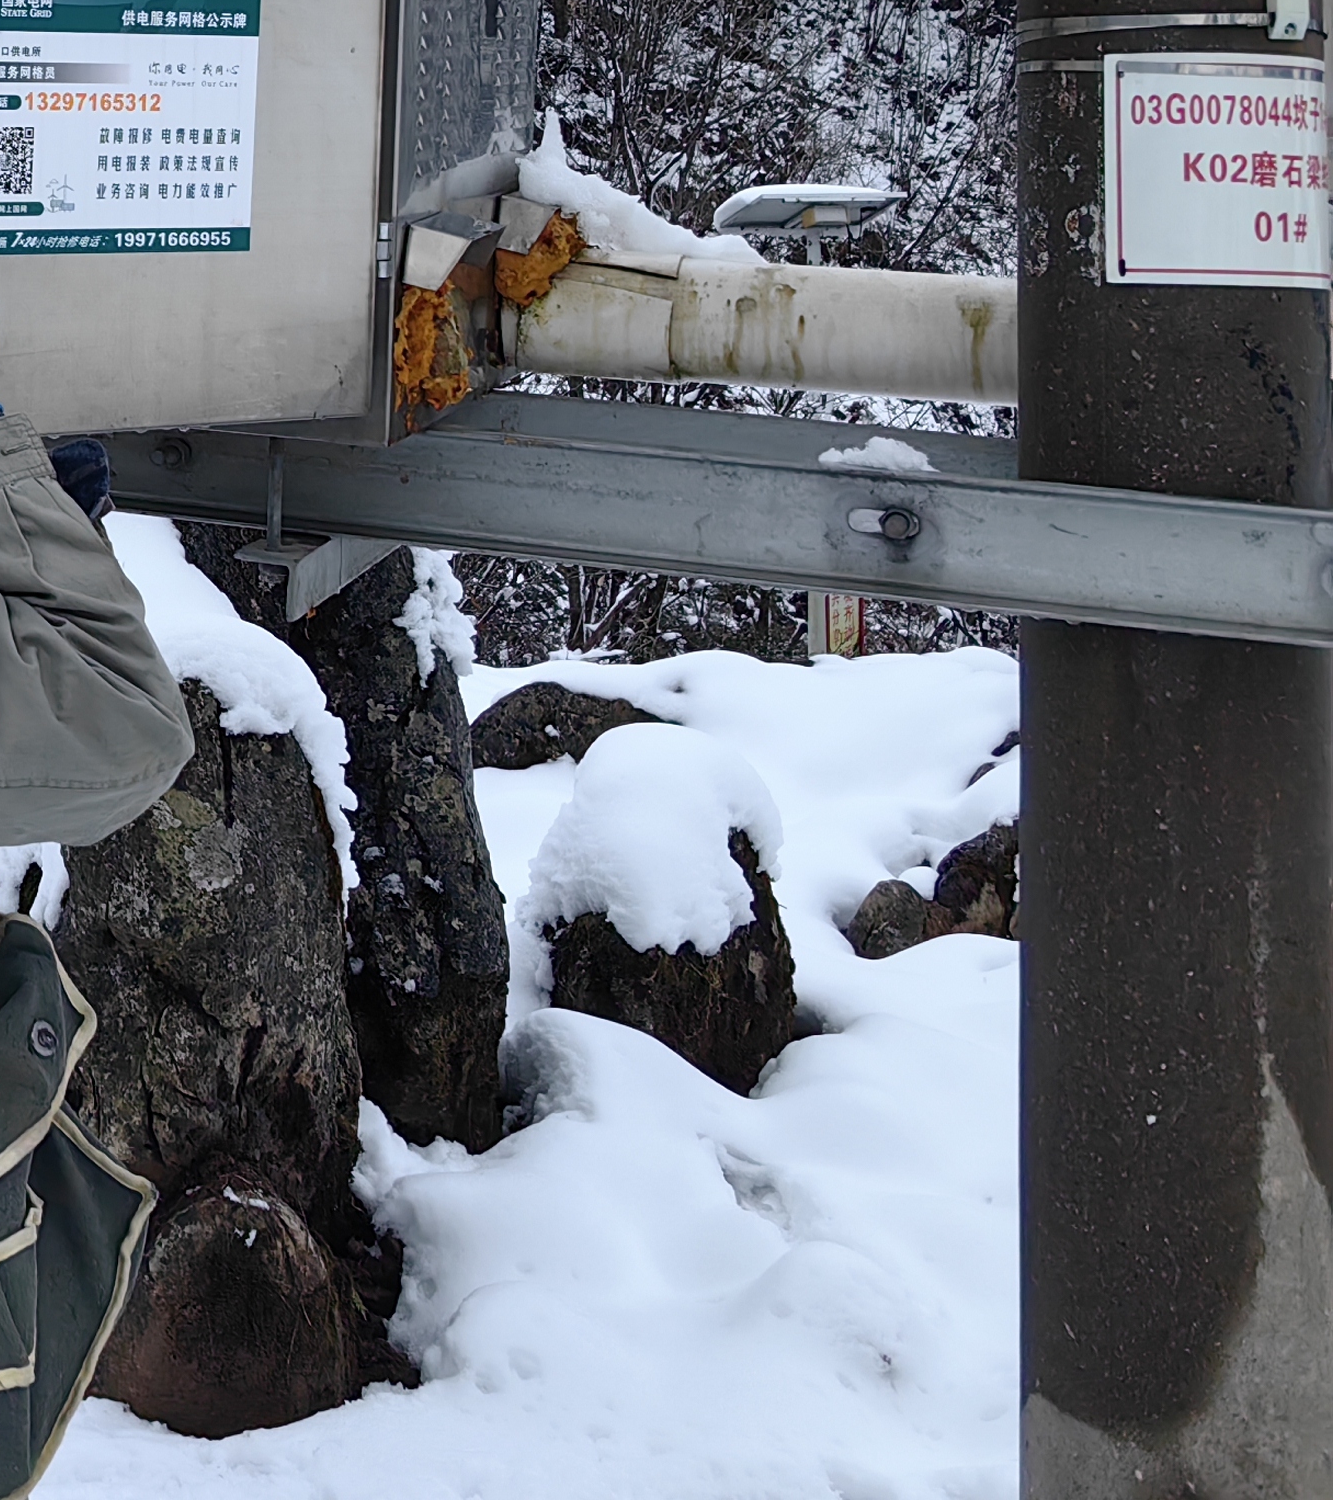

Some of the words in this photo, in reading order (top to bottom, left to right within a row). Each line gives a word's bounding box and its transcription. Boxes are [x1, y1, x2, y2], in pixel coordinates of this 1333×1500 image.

[1, 8, 26, 18] STATE
[29, 8, 53, 18] GRID
[121, 10, 247, 29] 供电服务网格公示牌
[25, 92, 162, 112] 13297165312
[99, 127, 153, 145] 故障报修
[161, 128, 241, 146] 电费电量查询
[97, 155, 151, 172] 用电报装
[159, 155, 240, 172] 政策法规宣传
[96, 183, 149, 200] 业务咨询
[158, 183, 238, 200] 电力能效推广
[1254, 211, 1308, 244] 01#
[114, 232, 231, 248] 19971666955
